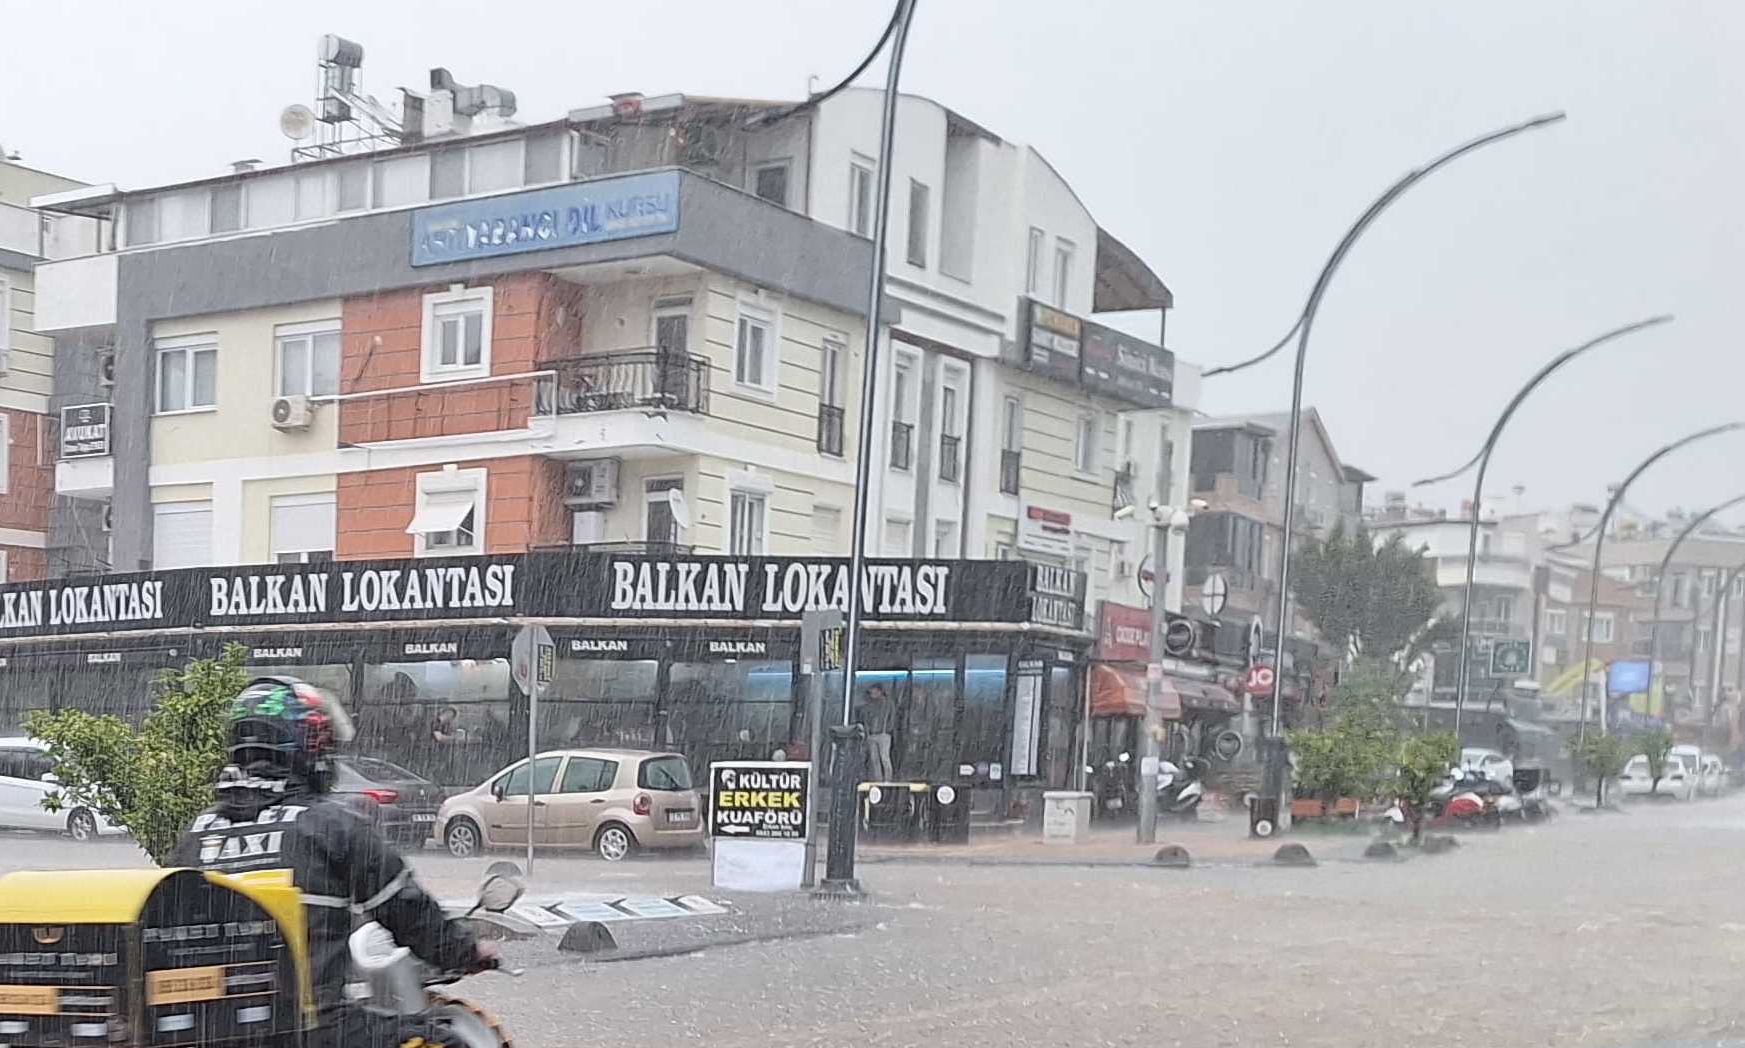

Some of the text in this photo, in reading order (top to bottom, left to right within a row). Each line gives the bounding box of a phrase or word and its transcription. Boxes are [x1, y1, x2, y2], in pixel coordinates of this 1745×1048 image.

[209, 564, 515, 616] BALKAN LOKANTASI
[610, 560, 950, 614] BALKAN LOKANTASI
[49, 580, 164, 625] LOKANTASI
[254, 647, 303, 658] BALKAN
[405, 642, 457, 654] BALKAN
[571, 640, 628, 651] BALKAN
[709, 641, 766, 653] BALKAN
[739, 771, 801, 789] KÜLTÜR
[719, 791, 801, 808] ERKEK
[716, 809, 803, 825] KUAFÖRÜ
